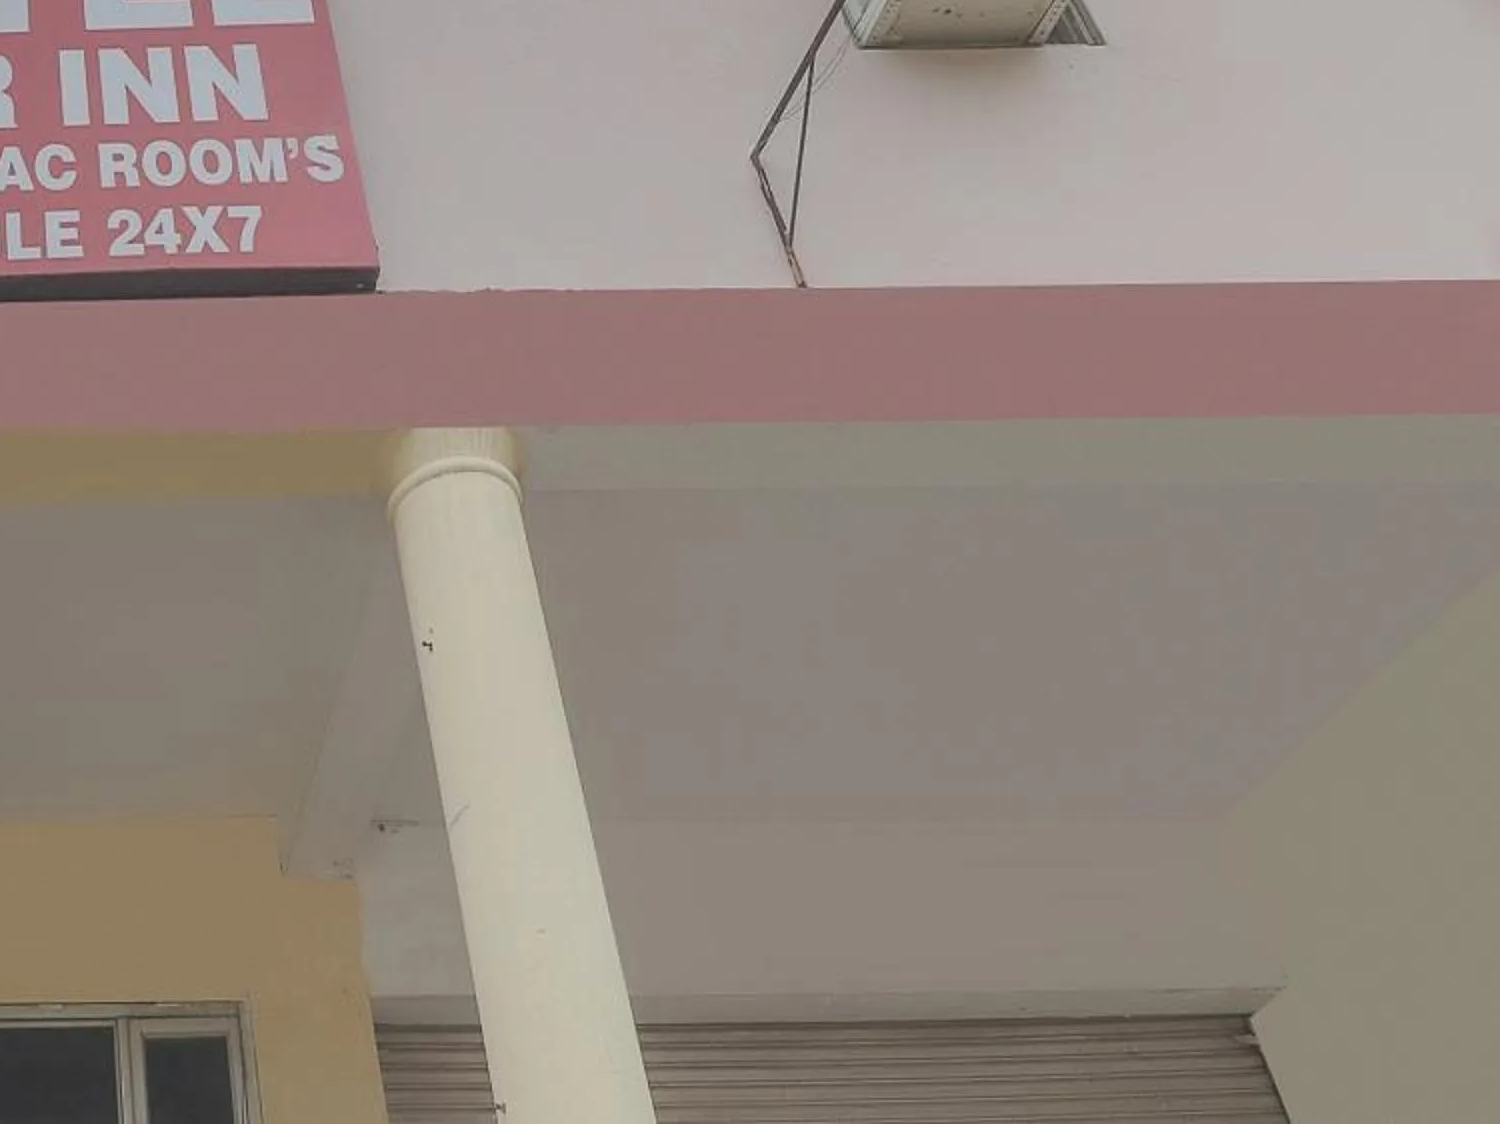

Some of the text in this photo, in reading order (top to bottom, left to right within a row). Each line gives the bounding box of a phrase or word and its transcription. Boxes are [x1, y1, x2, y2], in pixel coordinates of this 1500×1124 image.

[58, 44, 269, 126] INN
[98, 135, 344, 188] ROOM'S
[107, 205, 262, 256] 24X7
